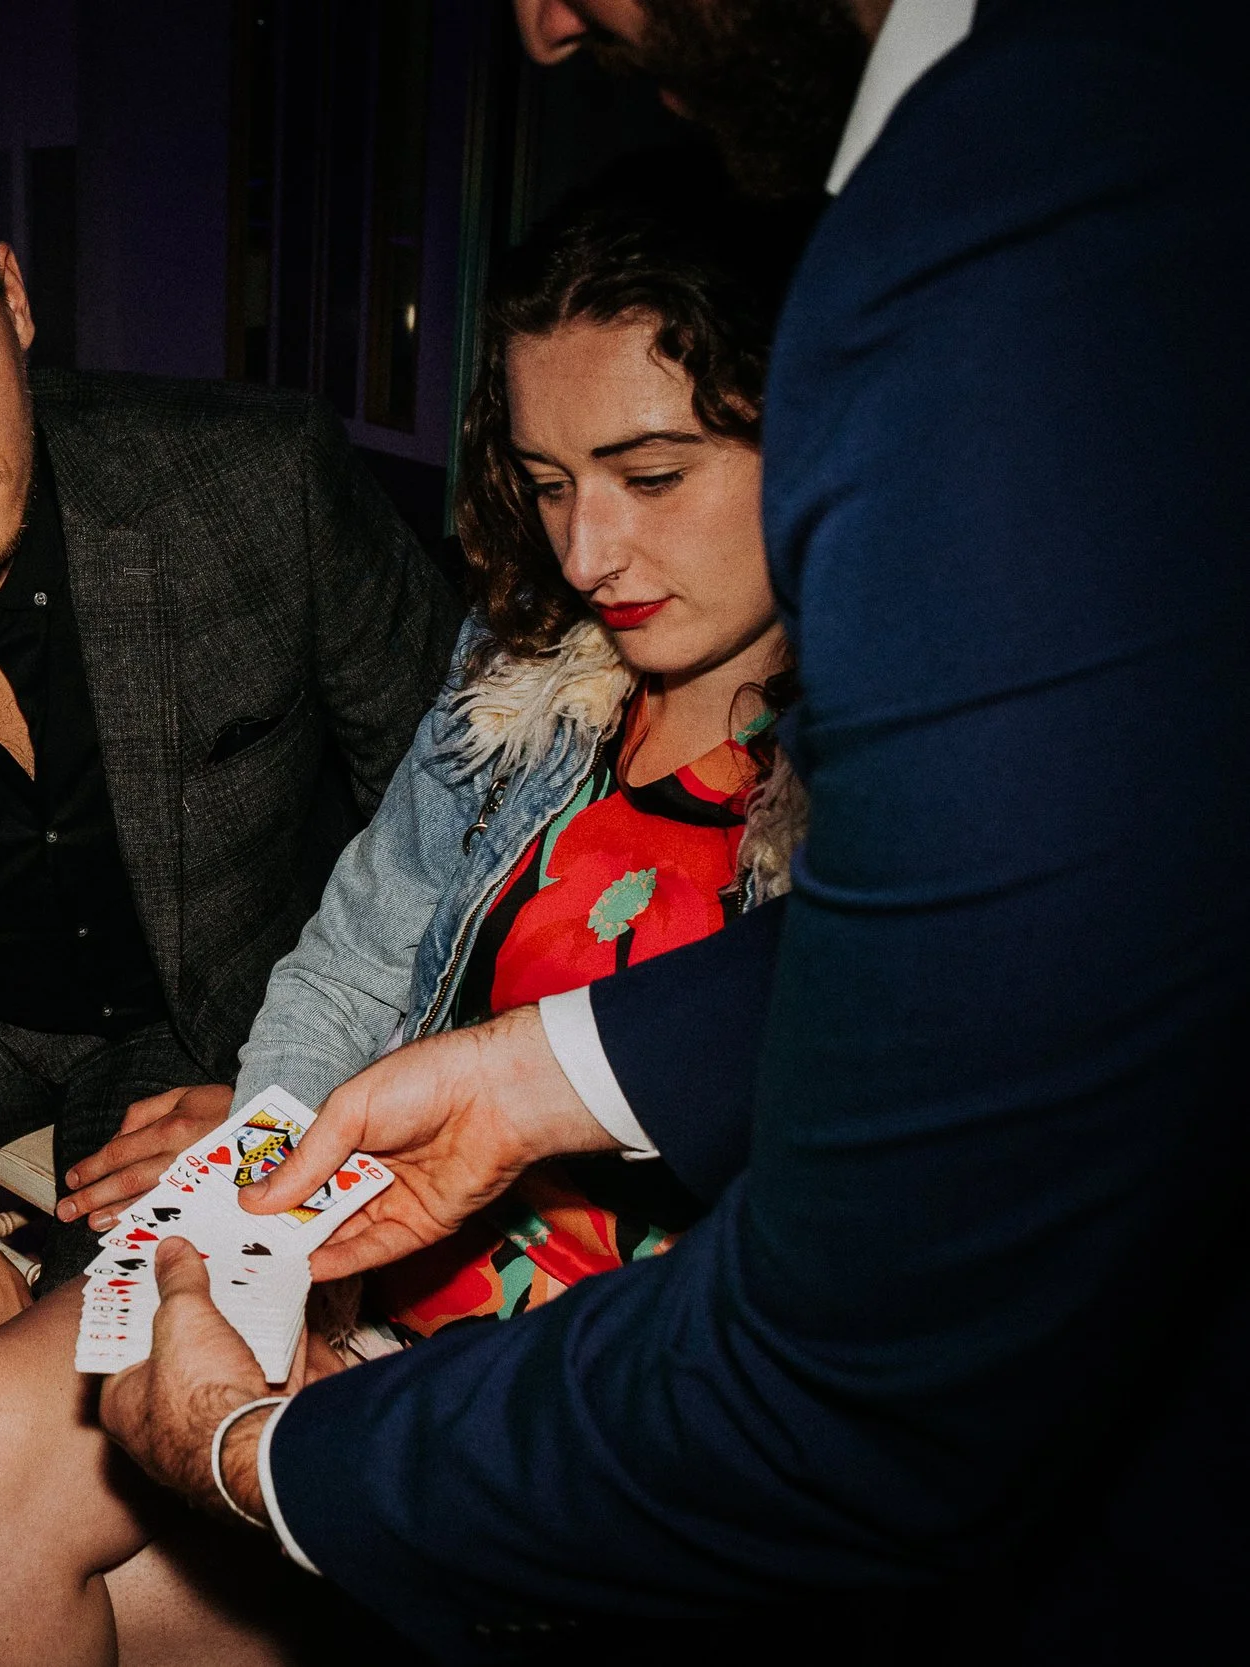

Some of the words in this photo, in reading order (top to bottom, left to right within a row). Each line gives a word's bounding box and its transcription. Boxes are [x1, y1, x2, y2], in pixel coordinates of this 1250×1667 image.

[186, 1155, 203, 1168] Q
[366, 1167, 384, 1180] Q
[131, 1213, 146, 1223] 4
[109, 1238, 128, 1247] 8
